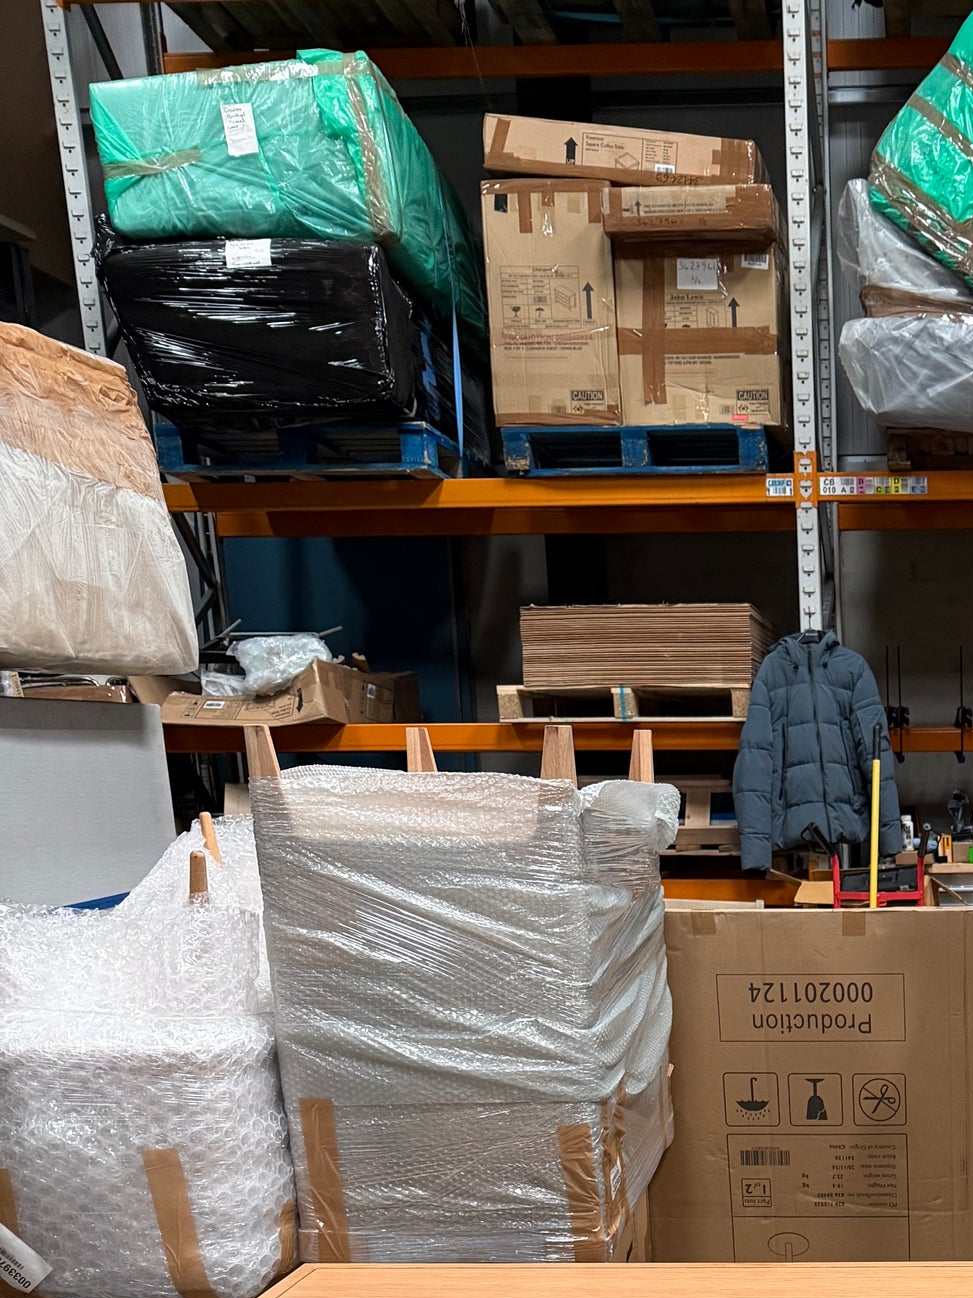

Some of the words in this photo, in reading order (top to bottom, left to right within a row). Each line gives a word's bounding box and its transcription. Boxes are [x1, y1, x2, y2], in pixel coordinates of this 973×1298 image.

[572, 391, 603, 401] CAUTION
[738, 391, 768, 401] CAUTION
[823, 478, 836, 486] CB
[822, 486, 836, 494] 010
[748, 982, 873, 1003] 000201124
[752, 1014, 872, 1035] Production
[744, 1184, 753, 1195] 2
[762, 1184, 767, 1195] 1
[0, 1257, 32, 1289] 003397
